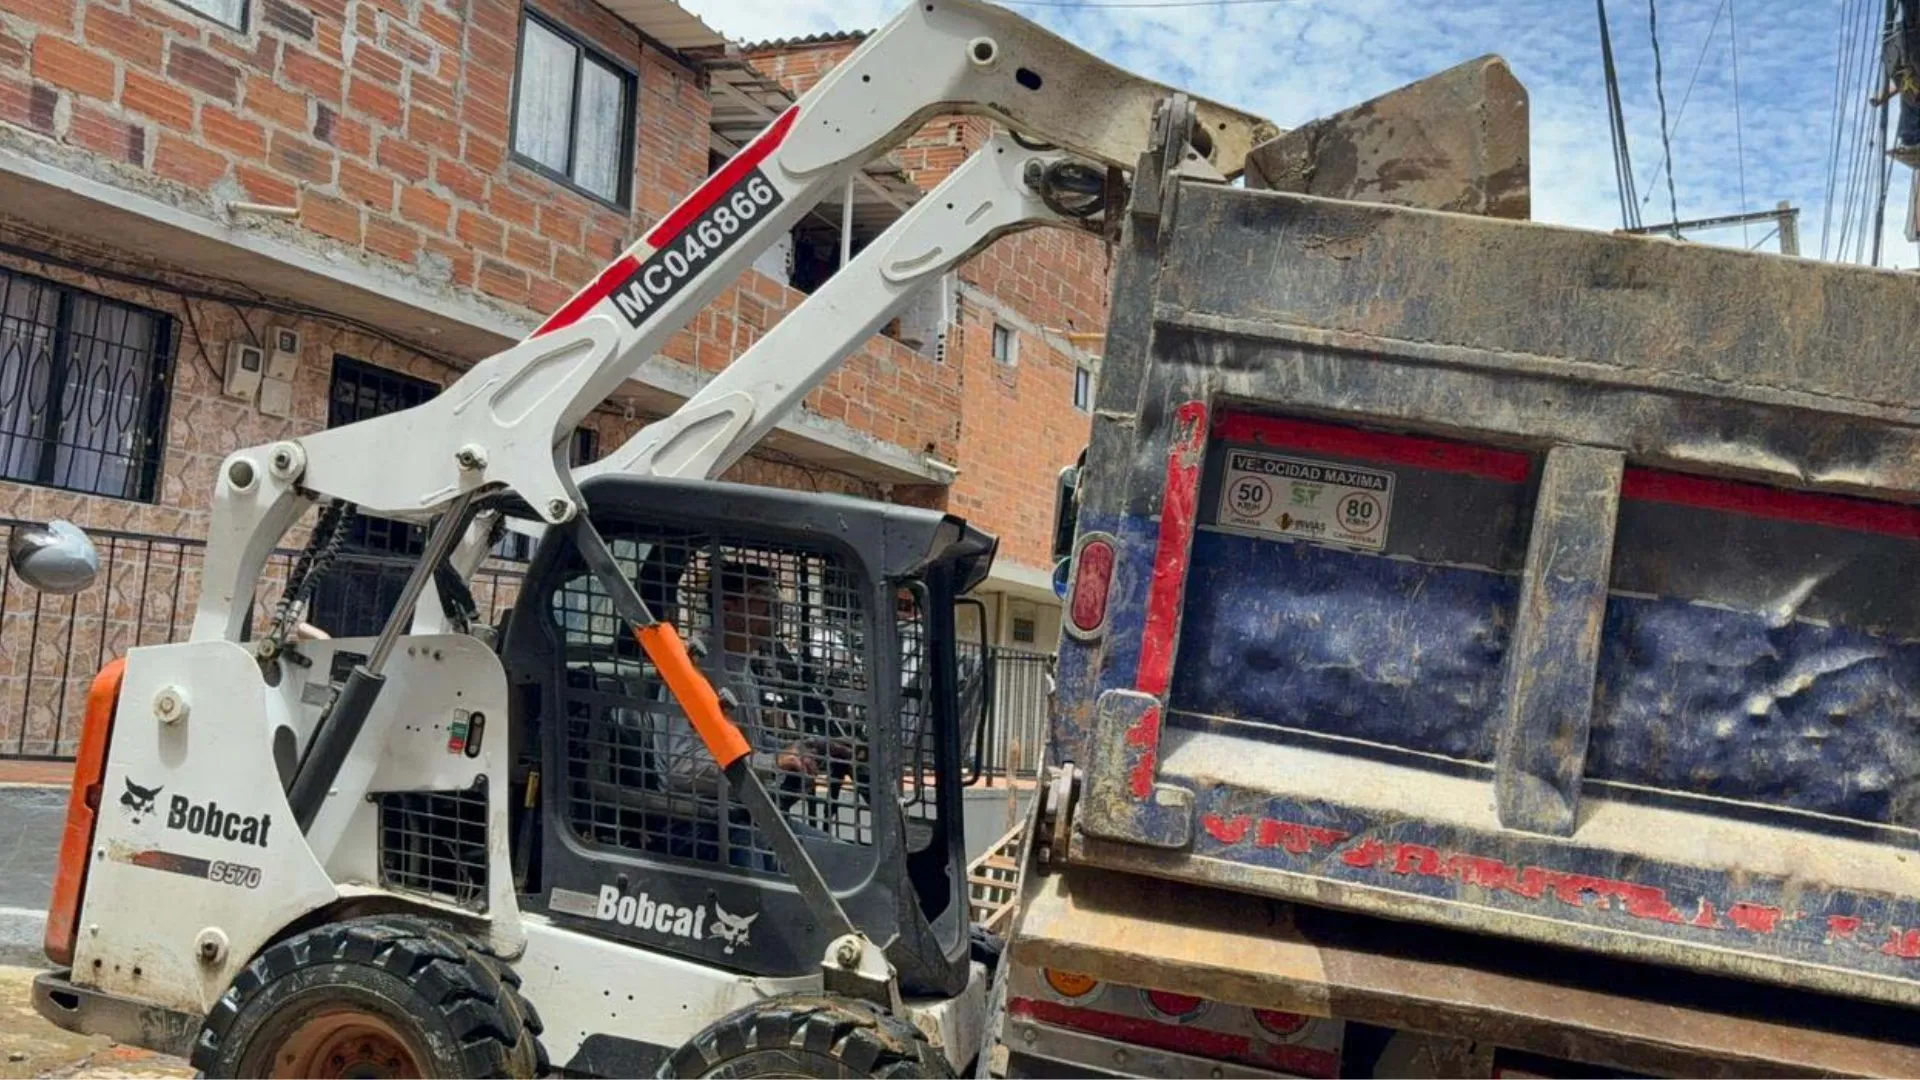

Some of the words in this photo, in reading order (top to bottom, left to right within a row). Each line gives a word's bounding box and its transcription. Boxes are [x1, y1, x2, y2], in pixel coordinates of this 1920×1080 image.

[616, 177, 773, 319] MC046866
[1238, 484, 1263, 502] 50
[1325, 469, 1383, 489] MAXIMA
[1346, 499, 1373, 518] 80
[167, 794, 271, 848] Bobcat
[210, 860, 262, 889] S570
[597, 884, 706, 940] Bobcat
